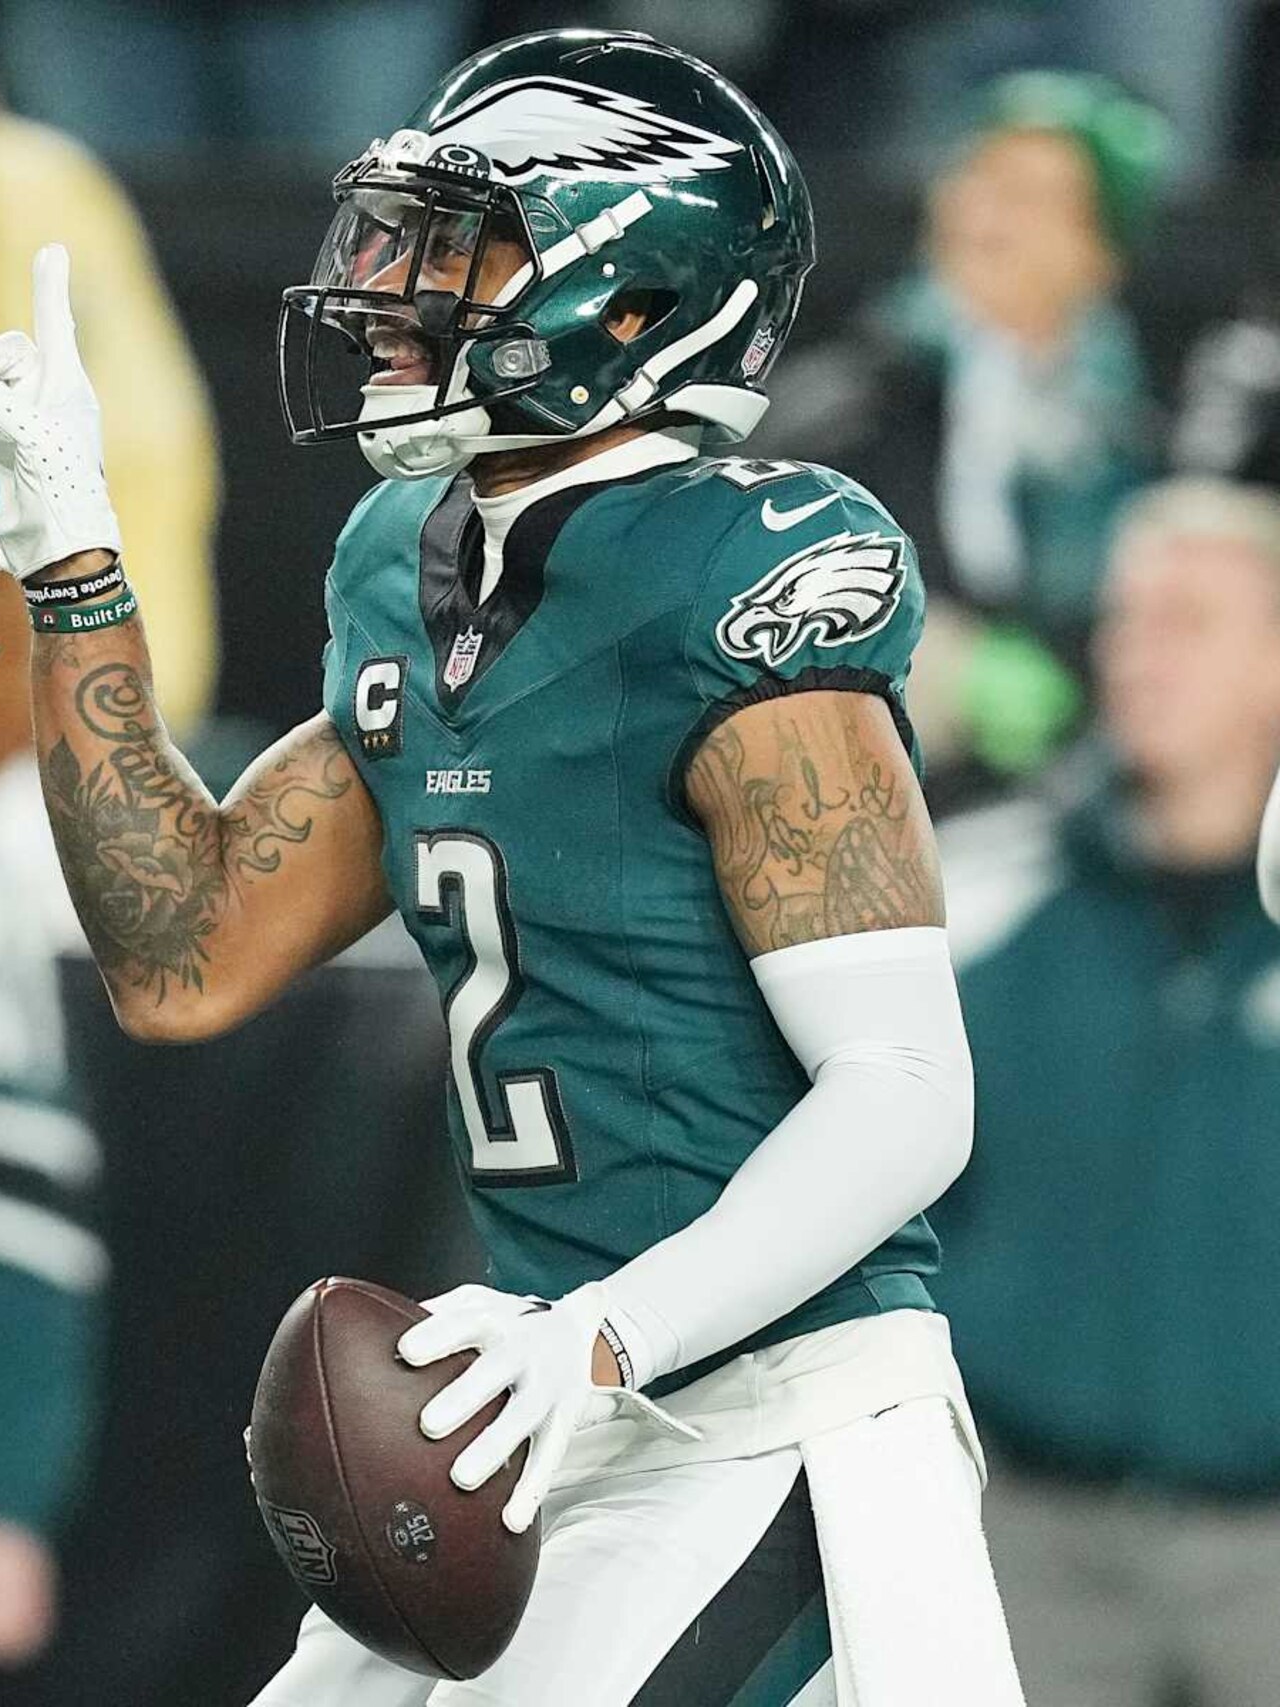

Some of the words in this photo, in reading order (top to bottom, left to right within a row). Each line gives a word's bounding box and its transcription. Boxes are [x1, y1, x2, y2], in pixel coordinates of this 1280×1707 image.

[427, 160, 488, 179] OAKLEY
[80, 568, 122, 593] Devote
[70, 608, 115, 628] Built
[355, 661, 401, 732] C
[425, 769, 493, 795] EAGLES
[413, 826, 580, 1189] 2
[286, 1519, 330, 1578] NFL
